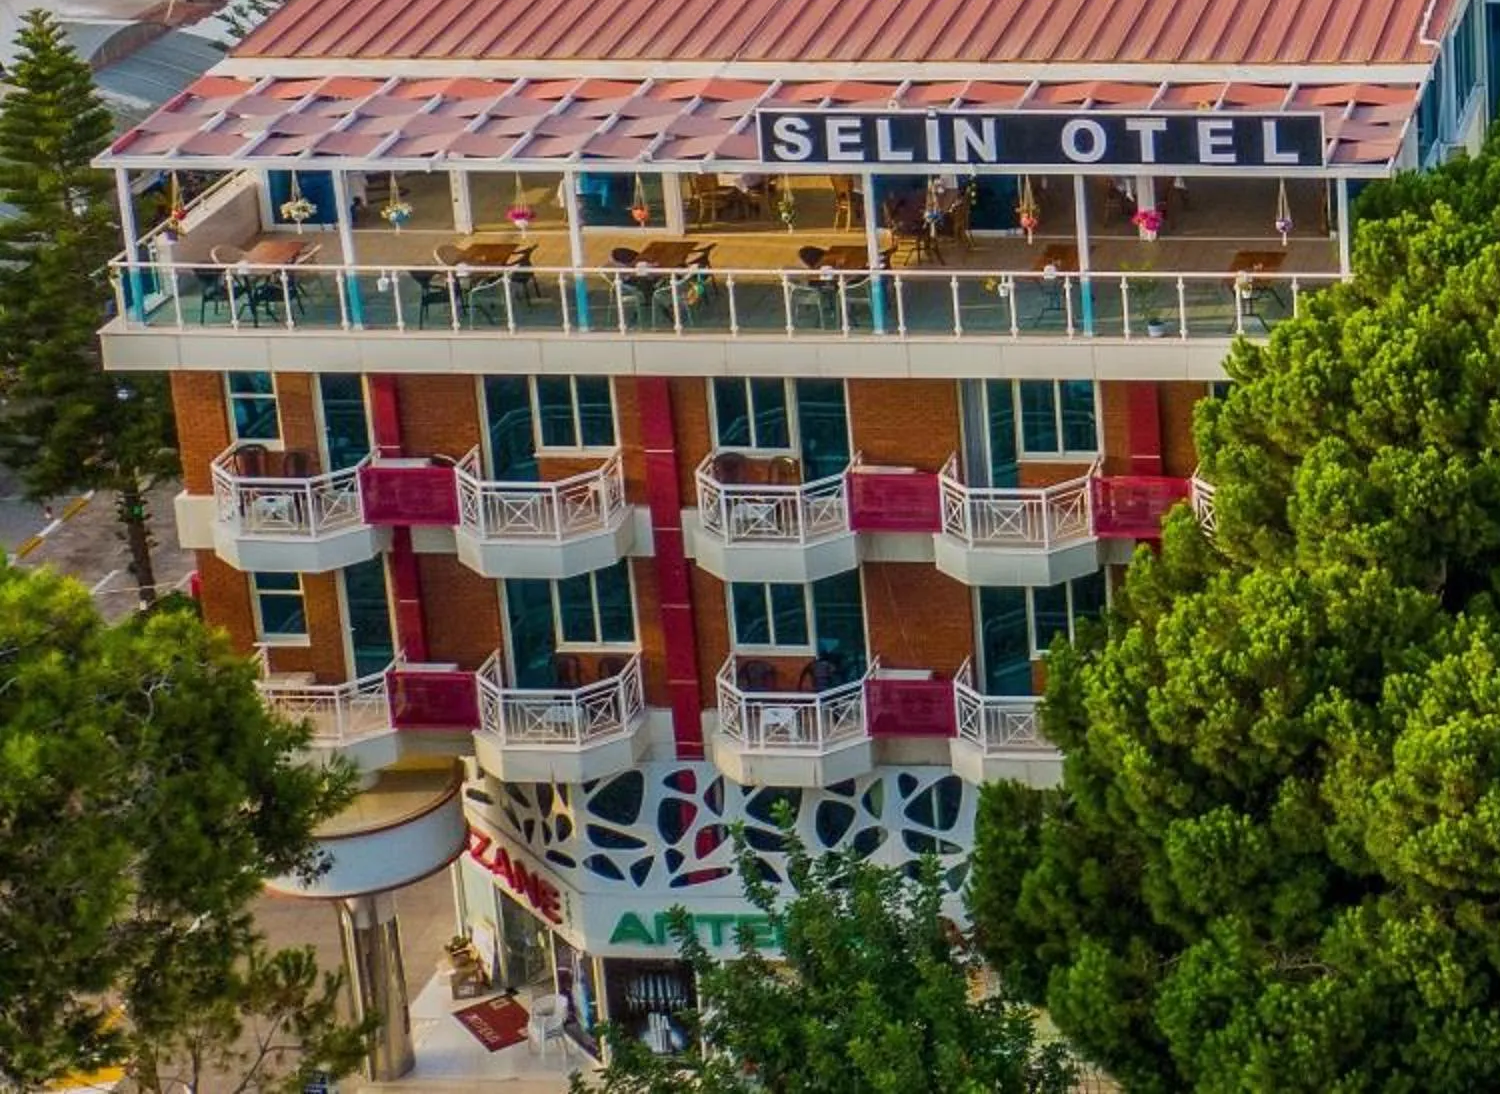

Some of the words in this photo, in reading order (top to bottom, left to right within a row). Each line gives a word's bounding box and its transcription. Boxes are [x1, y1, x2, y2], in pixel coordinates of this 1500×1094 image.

[773, 109, 998, 162] SELİN
[1061, 119, 1300, 164] OTEL
[609, 912, 785, 947] ANTE
